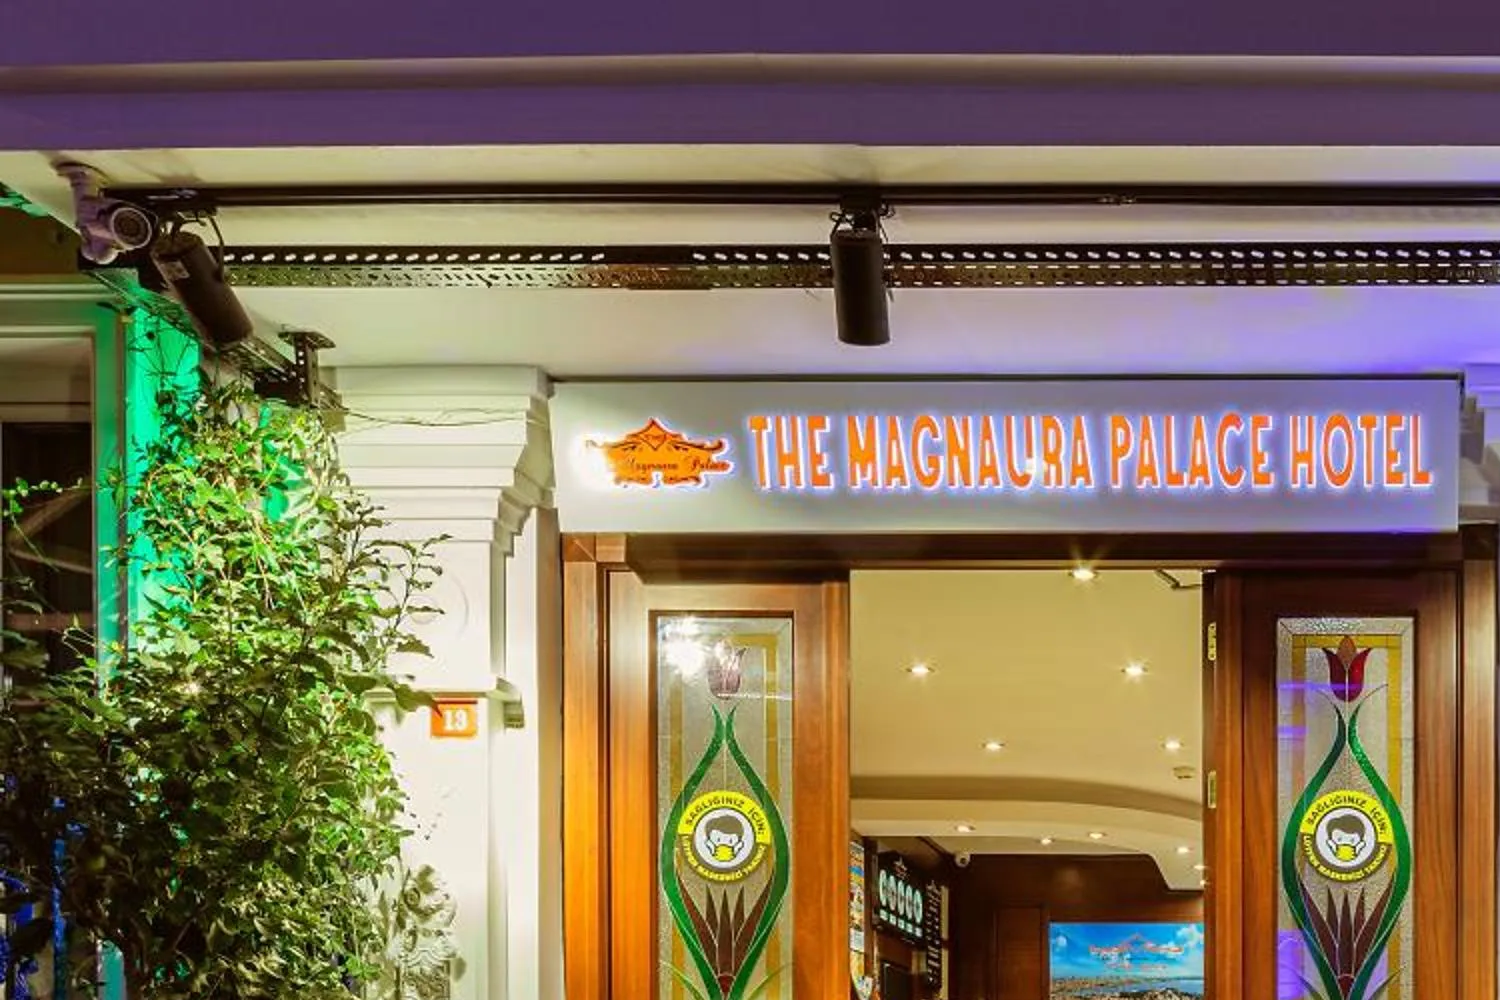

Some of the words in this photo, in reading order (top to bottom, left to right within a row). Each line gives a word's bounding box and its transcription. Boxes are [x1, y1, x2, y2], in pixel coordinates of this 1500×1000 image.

[748, 414, 834, 489] THE
[847, 413, 1095, 490] MAGNAURA
[1108, 412, 1275, 489] PALACE
[1290, 412, 1433, 489] HOTEL
